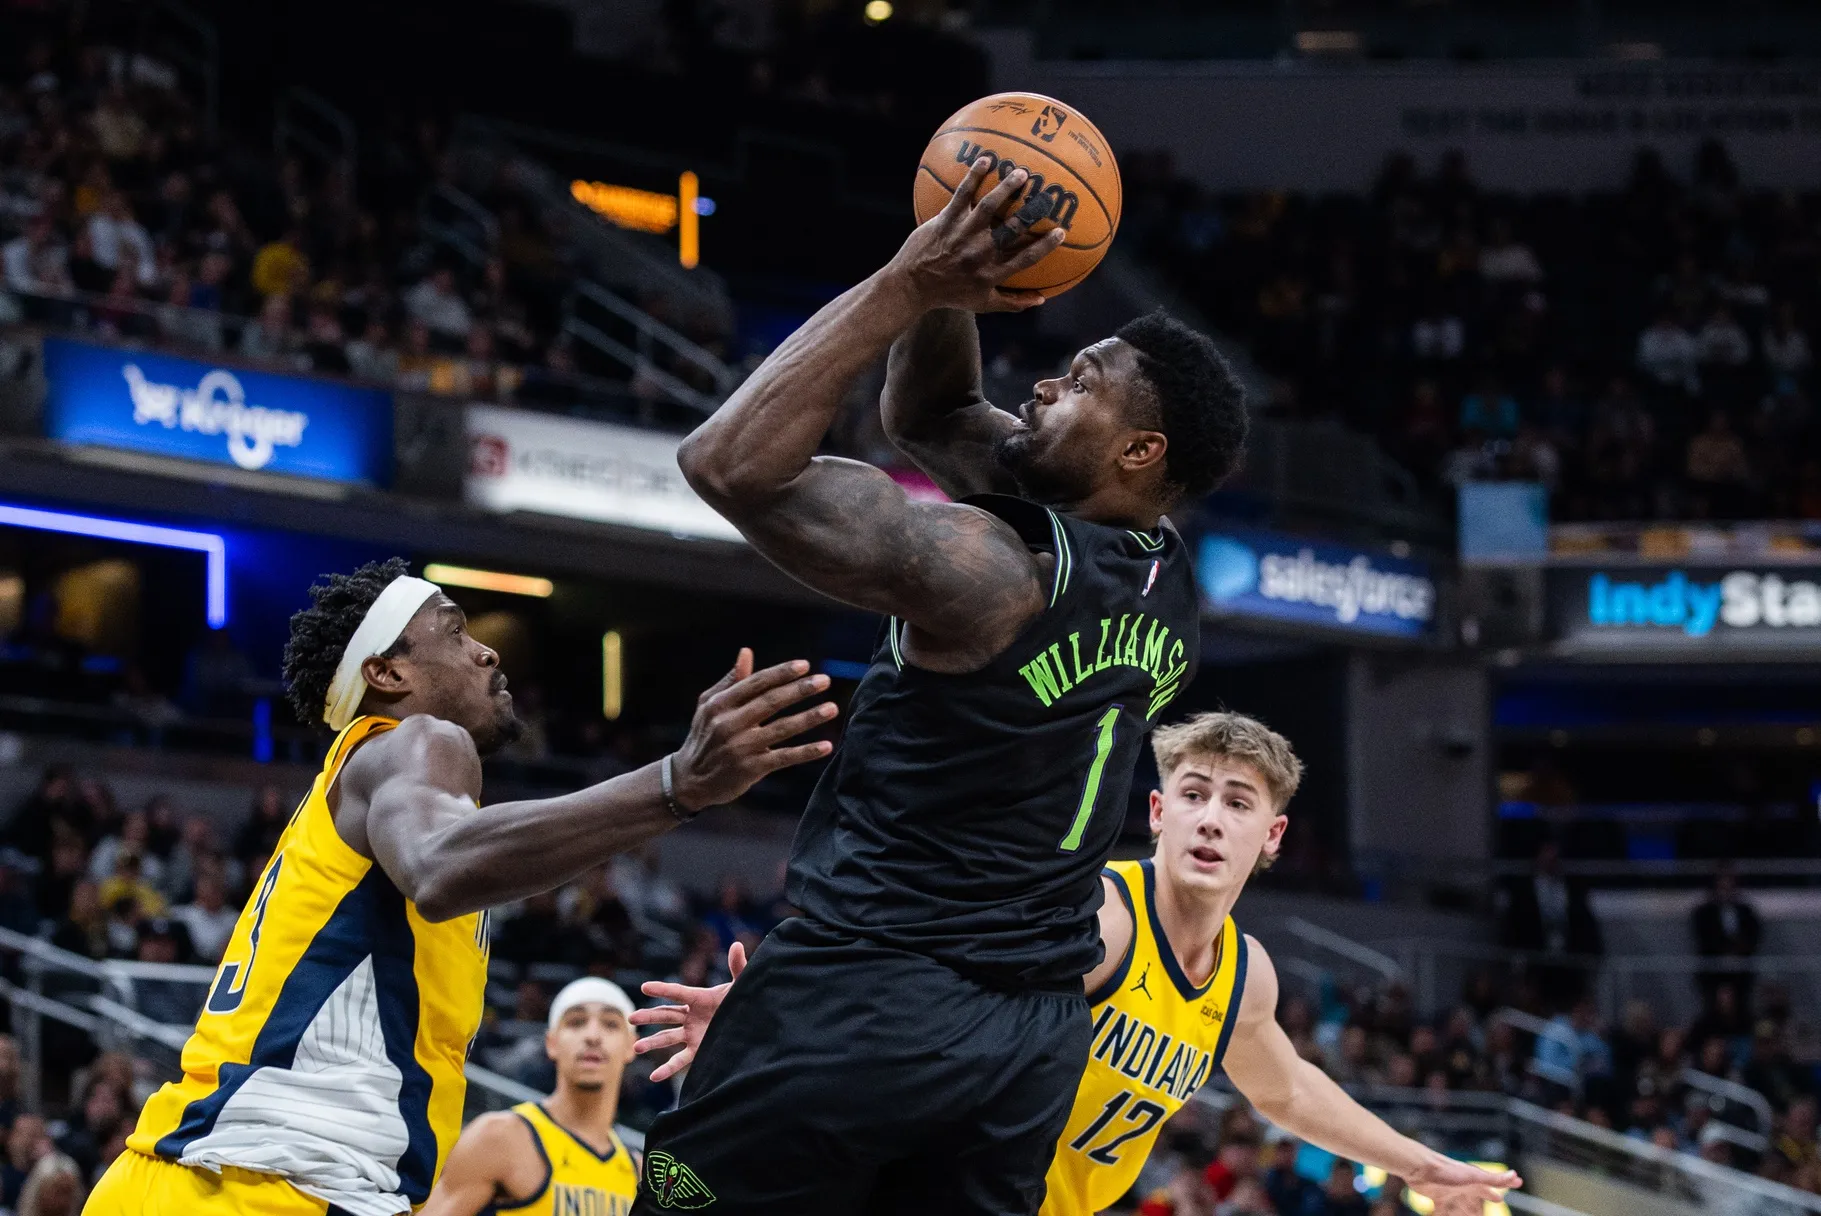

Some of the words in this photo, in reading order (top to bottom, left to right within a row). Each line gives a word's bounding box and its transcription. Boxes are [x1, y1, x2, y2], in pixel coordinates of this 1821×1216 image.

[1260, 549, 1434, 623] salesforce
[1056, 703, 1124, 855] 1
[1091, 1004, 1210, 1101] INDIANA
[1069, 1090, 1166, 1166] 12
